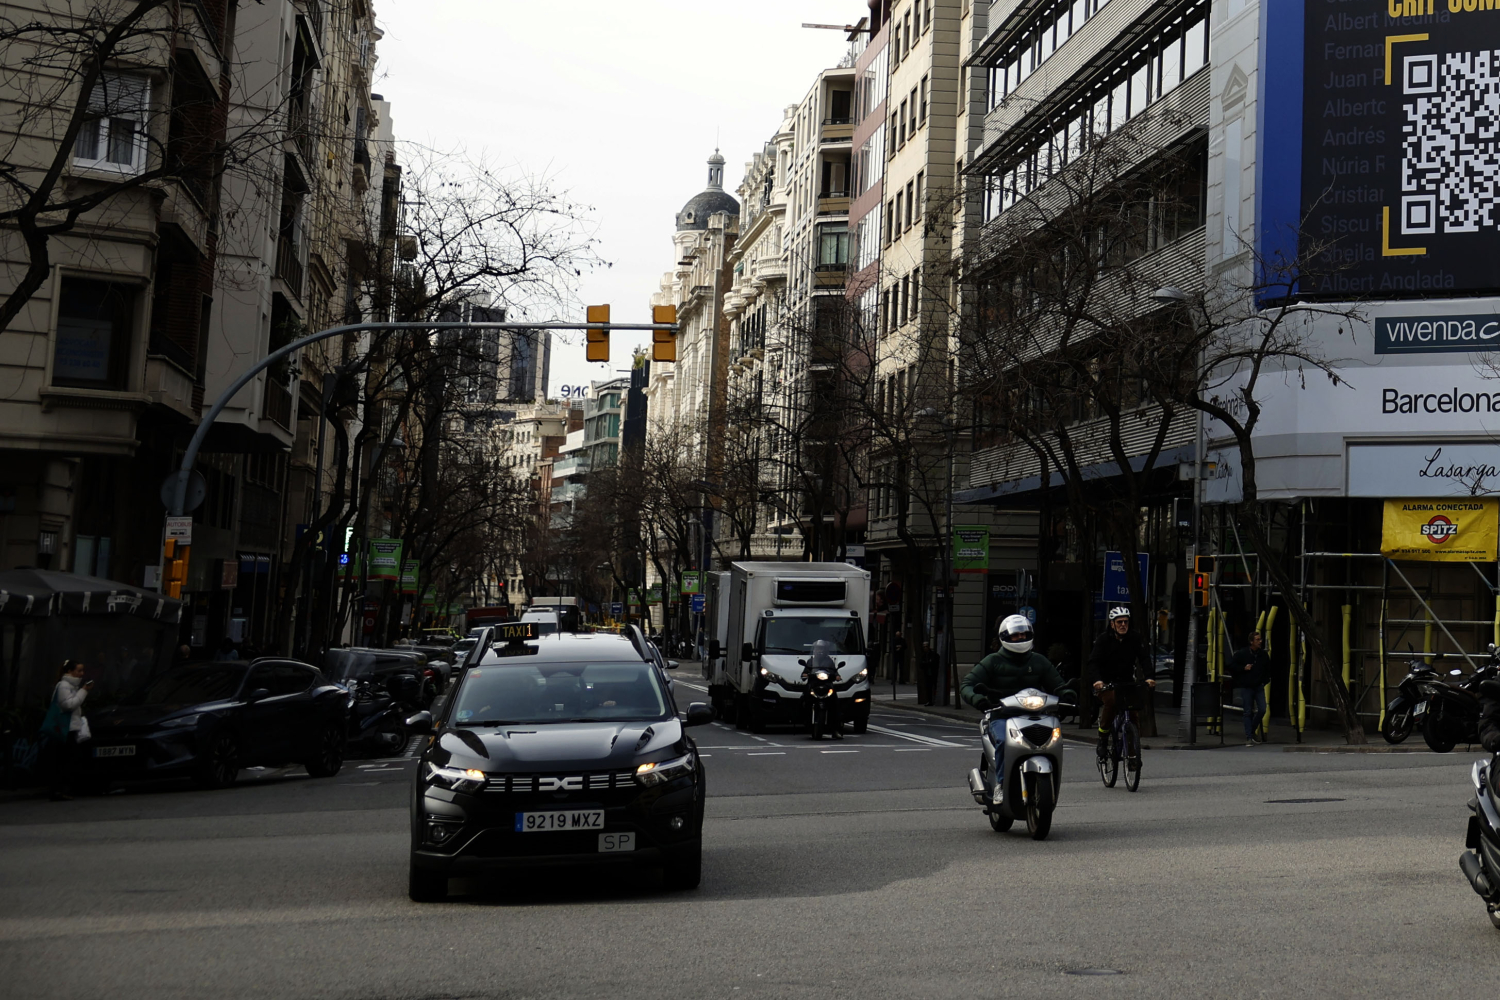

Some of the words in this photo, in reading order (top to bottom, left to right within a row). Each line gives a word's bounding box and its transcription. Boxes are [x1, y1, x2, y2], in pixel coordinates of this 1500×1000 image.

[1436, 503, 1484, 511] CONECTADA
[1422, 525, 1457, 534] SPITZ
[1117, 585, 1130, 594] tax
[502, 625, 525, 638] TAXI
[527, 813, 567, 829] 9219
[571, 812, 601, 828] MXZ
[604, 834, 630, 850] SP
